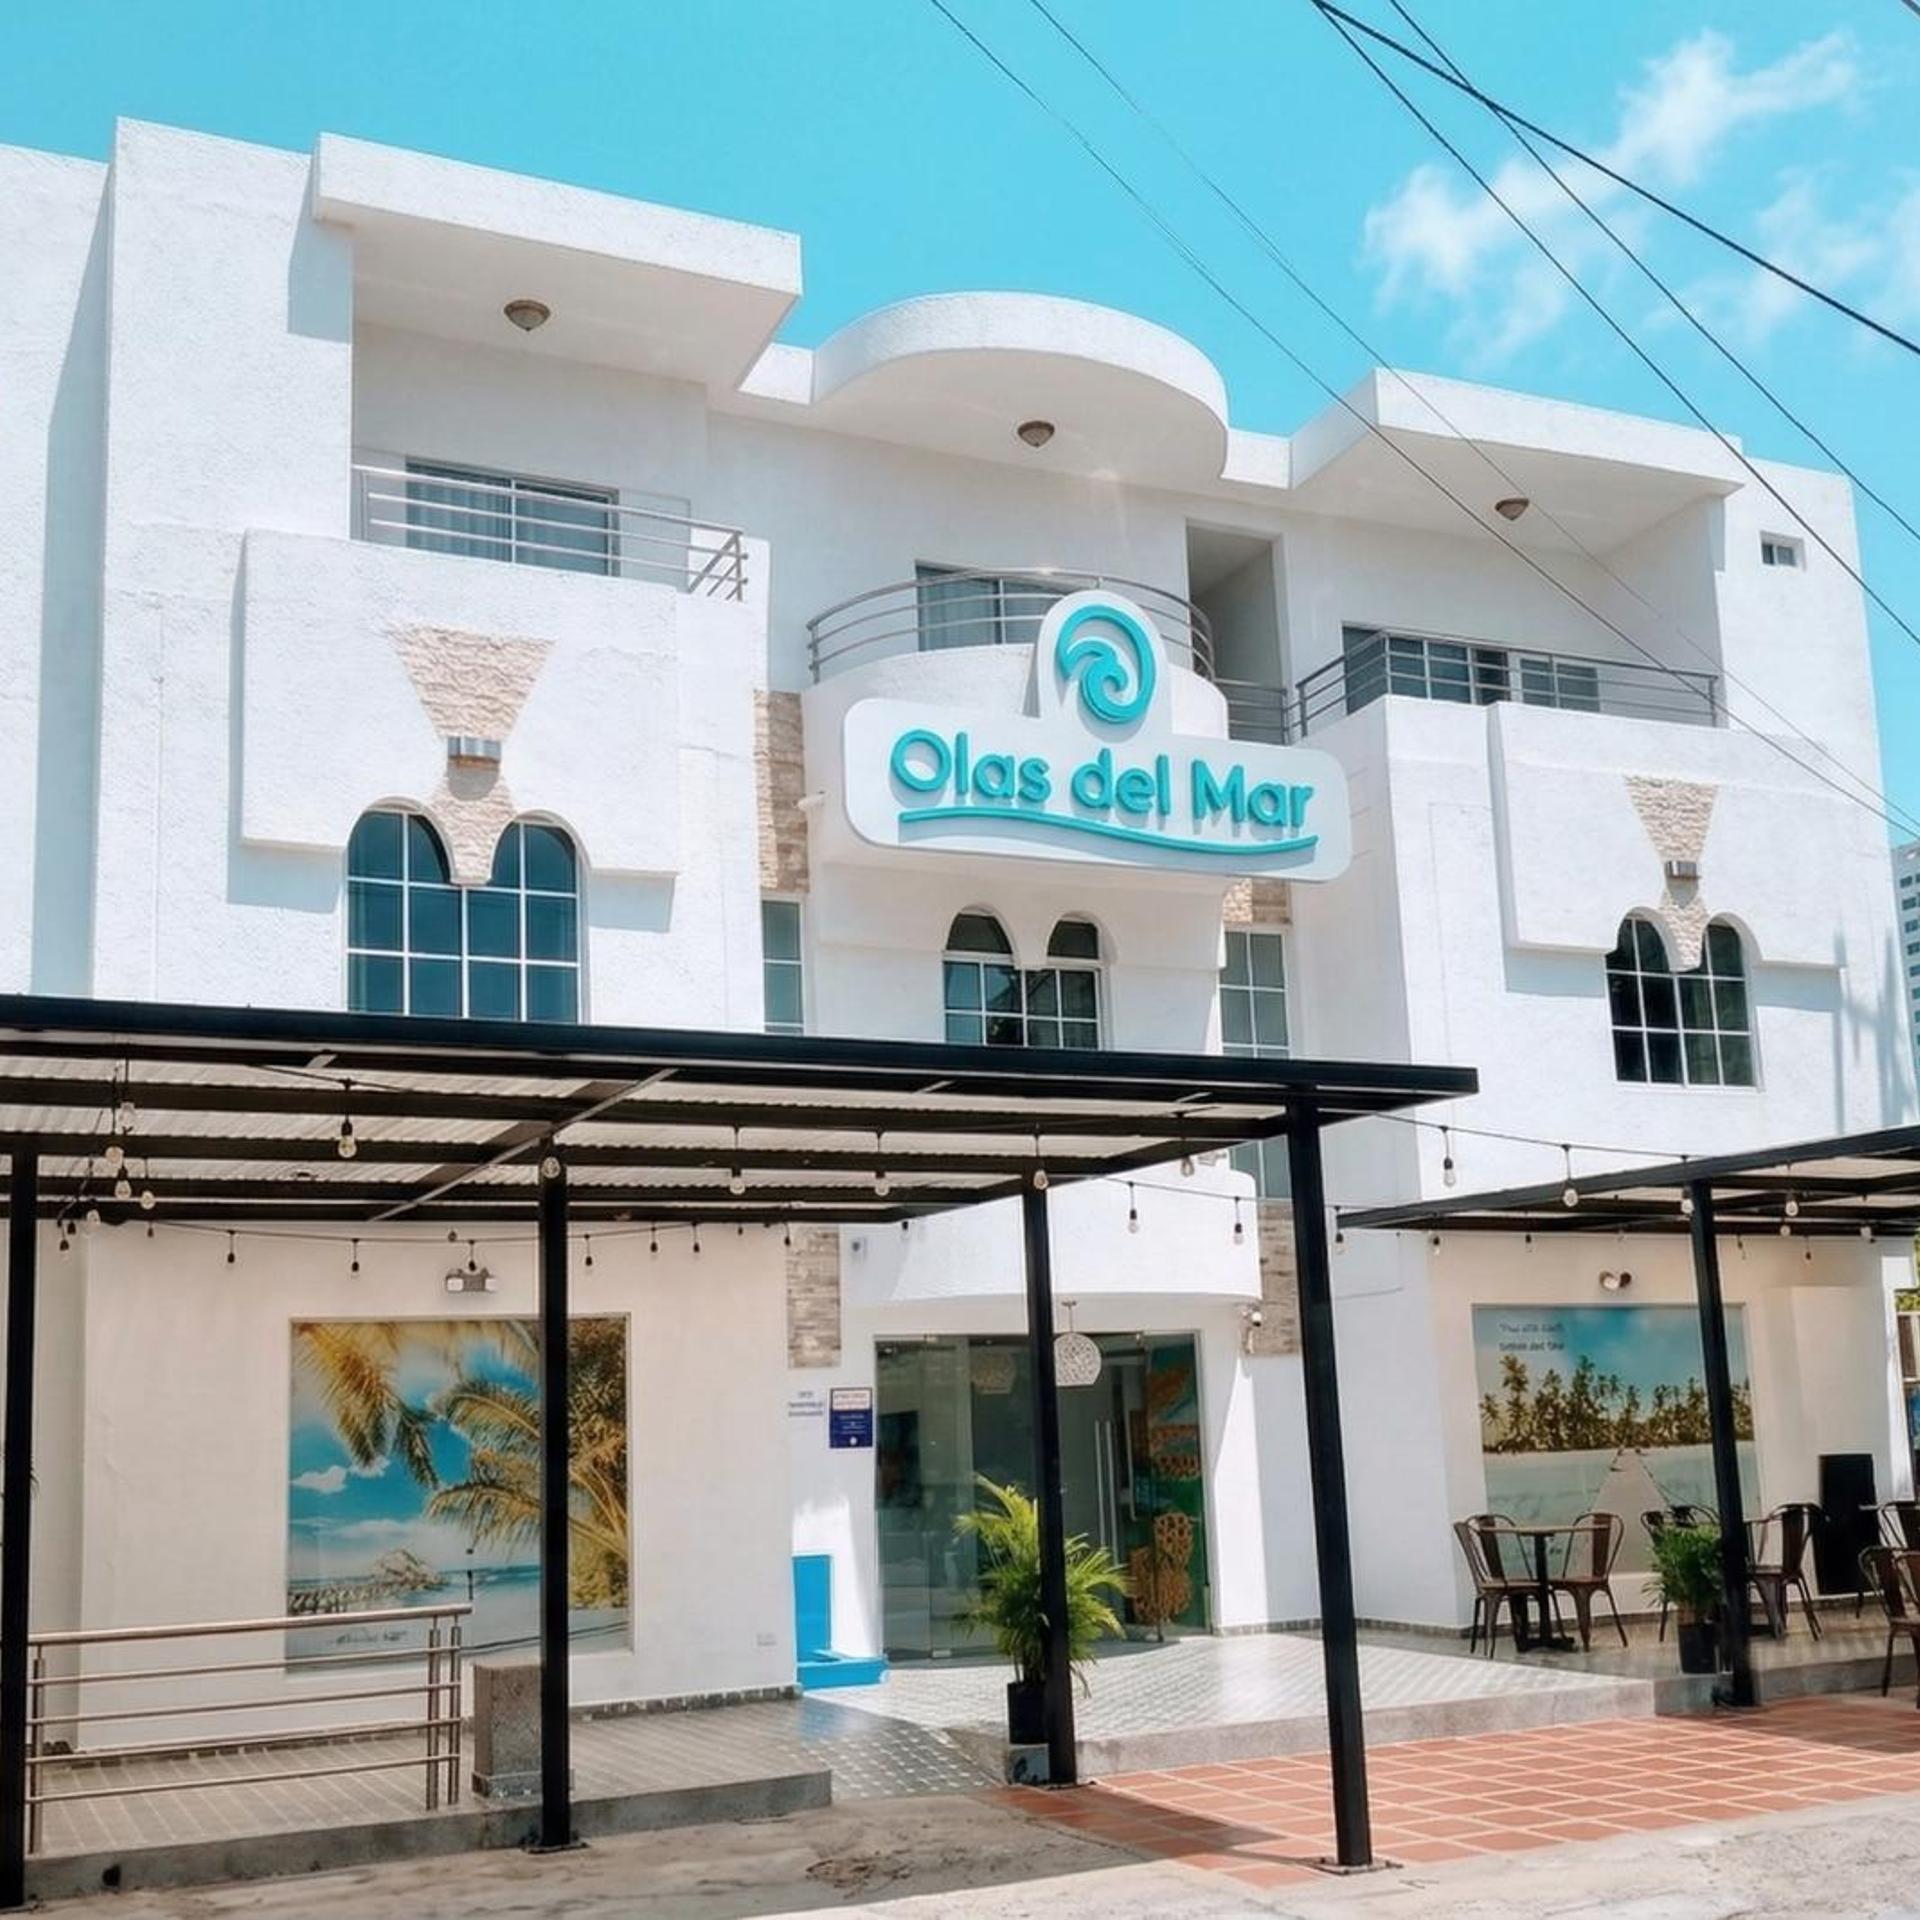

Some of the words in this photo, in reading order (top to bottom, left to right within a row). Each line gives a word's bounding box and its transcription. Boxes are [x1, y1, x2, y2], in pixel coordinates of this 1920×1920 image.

[890, 728, 1051, 803] Olas
[1071, 747, 1172, 817] del
[1191, 758, 1314, 829] Mar
